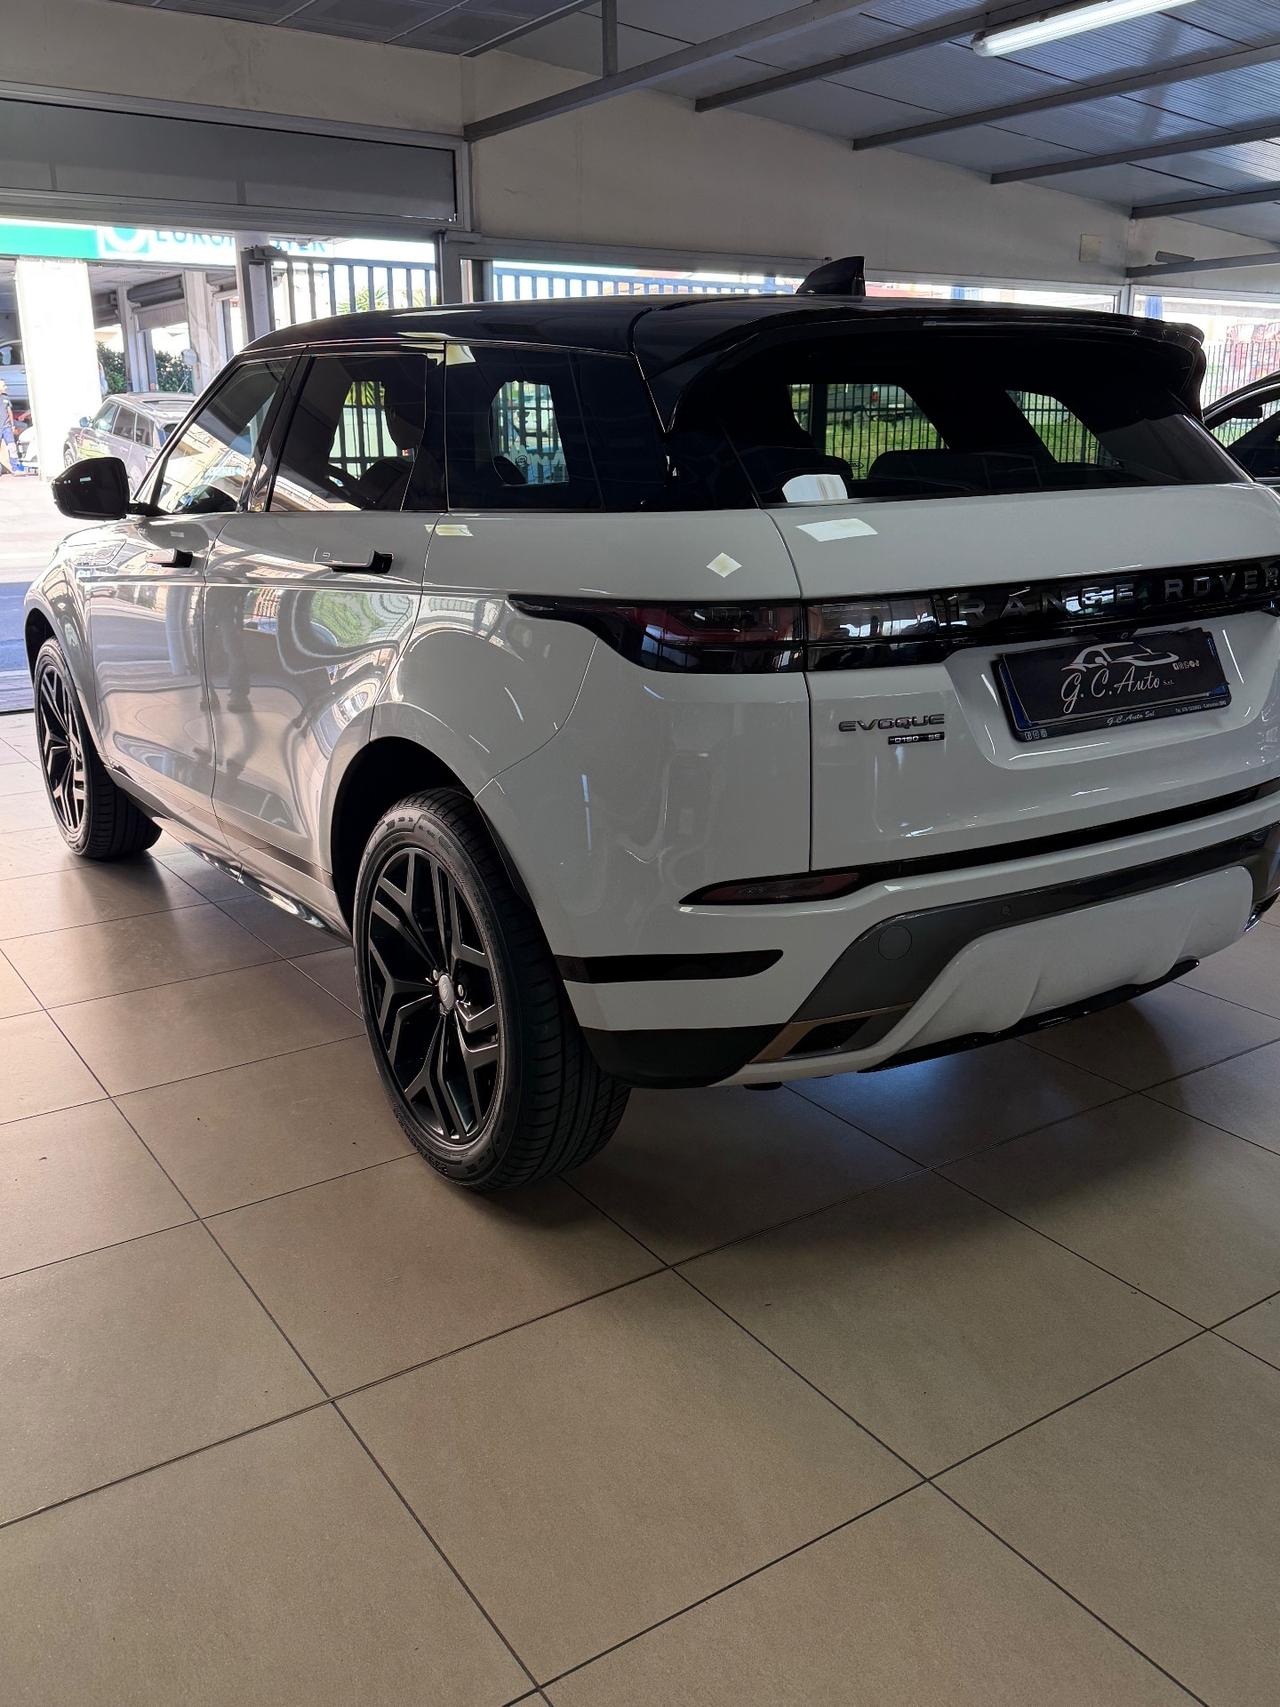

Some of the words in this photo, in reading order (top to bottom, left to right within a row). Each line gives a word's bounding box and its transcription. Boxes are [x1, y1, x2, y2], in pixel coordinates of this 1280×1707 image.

[957, 582, 1136, 621] RANGE
[1164, 566, 1280, 602] ROVER
[1113, 665, 1160, 696] Auto
[838, 713, 945, 733] EVOQUE
